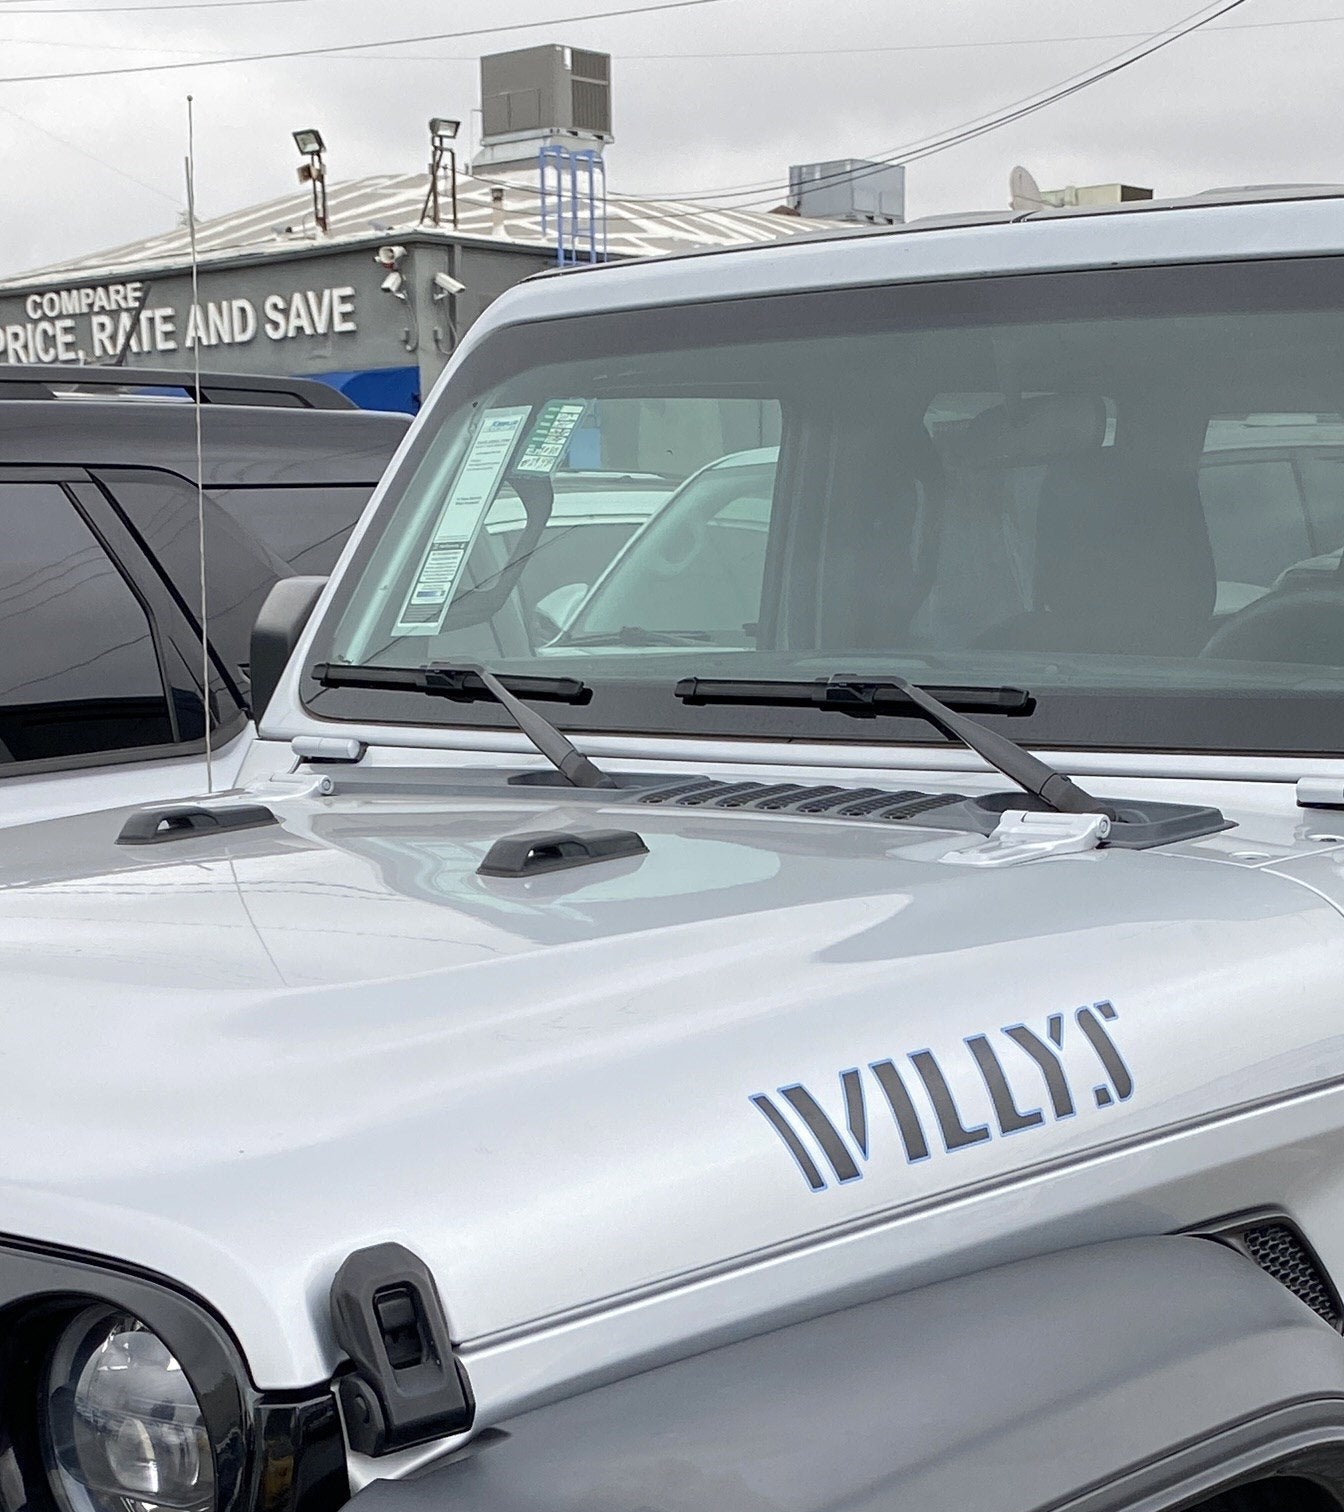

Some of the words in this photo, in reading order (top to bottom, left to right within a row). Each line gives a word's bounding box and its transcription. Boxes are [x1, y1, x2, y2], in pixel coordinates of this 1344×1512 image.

[25, 282, 144, 320] COMPARE
[90, 307, 178, 357] RATE
[185, 298, 256, 348] AND
[263, 286, 356, 340] SAVE
[748, 1000, 1135, 1192] WILLYS
